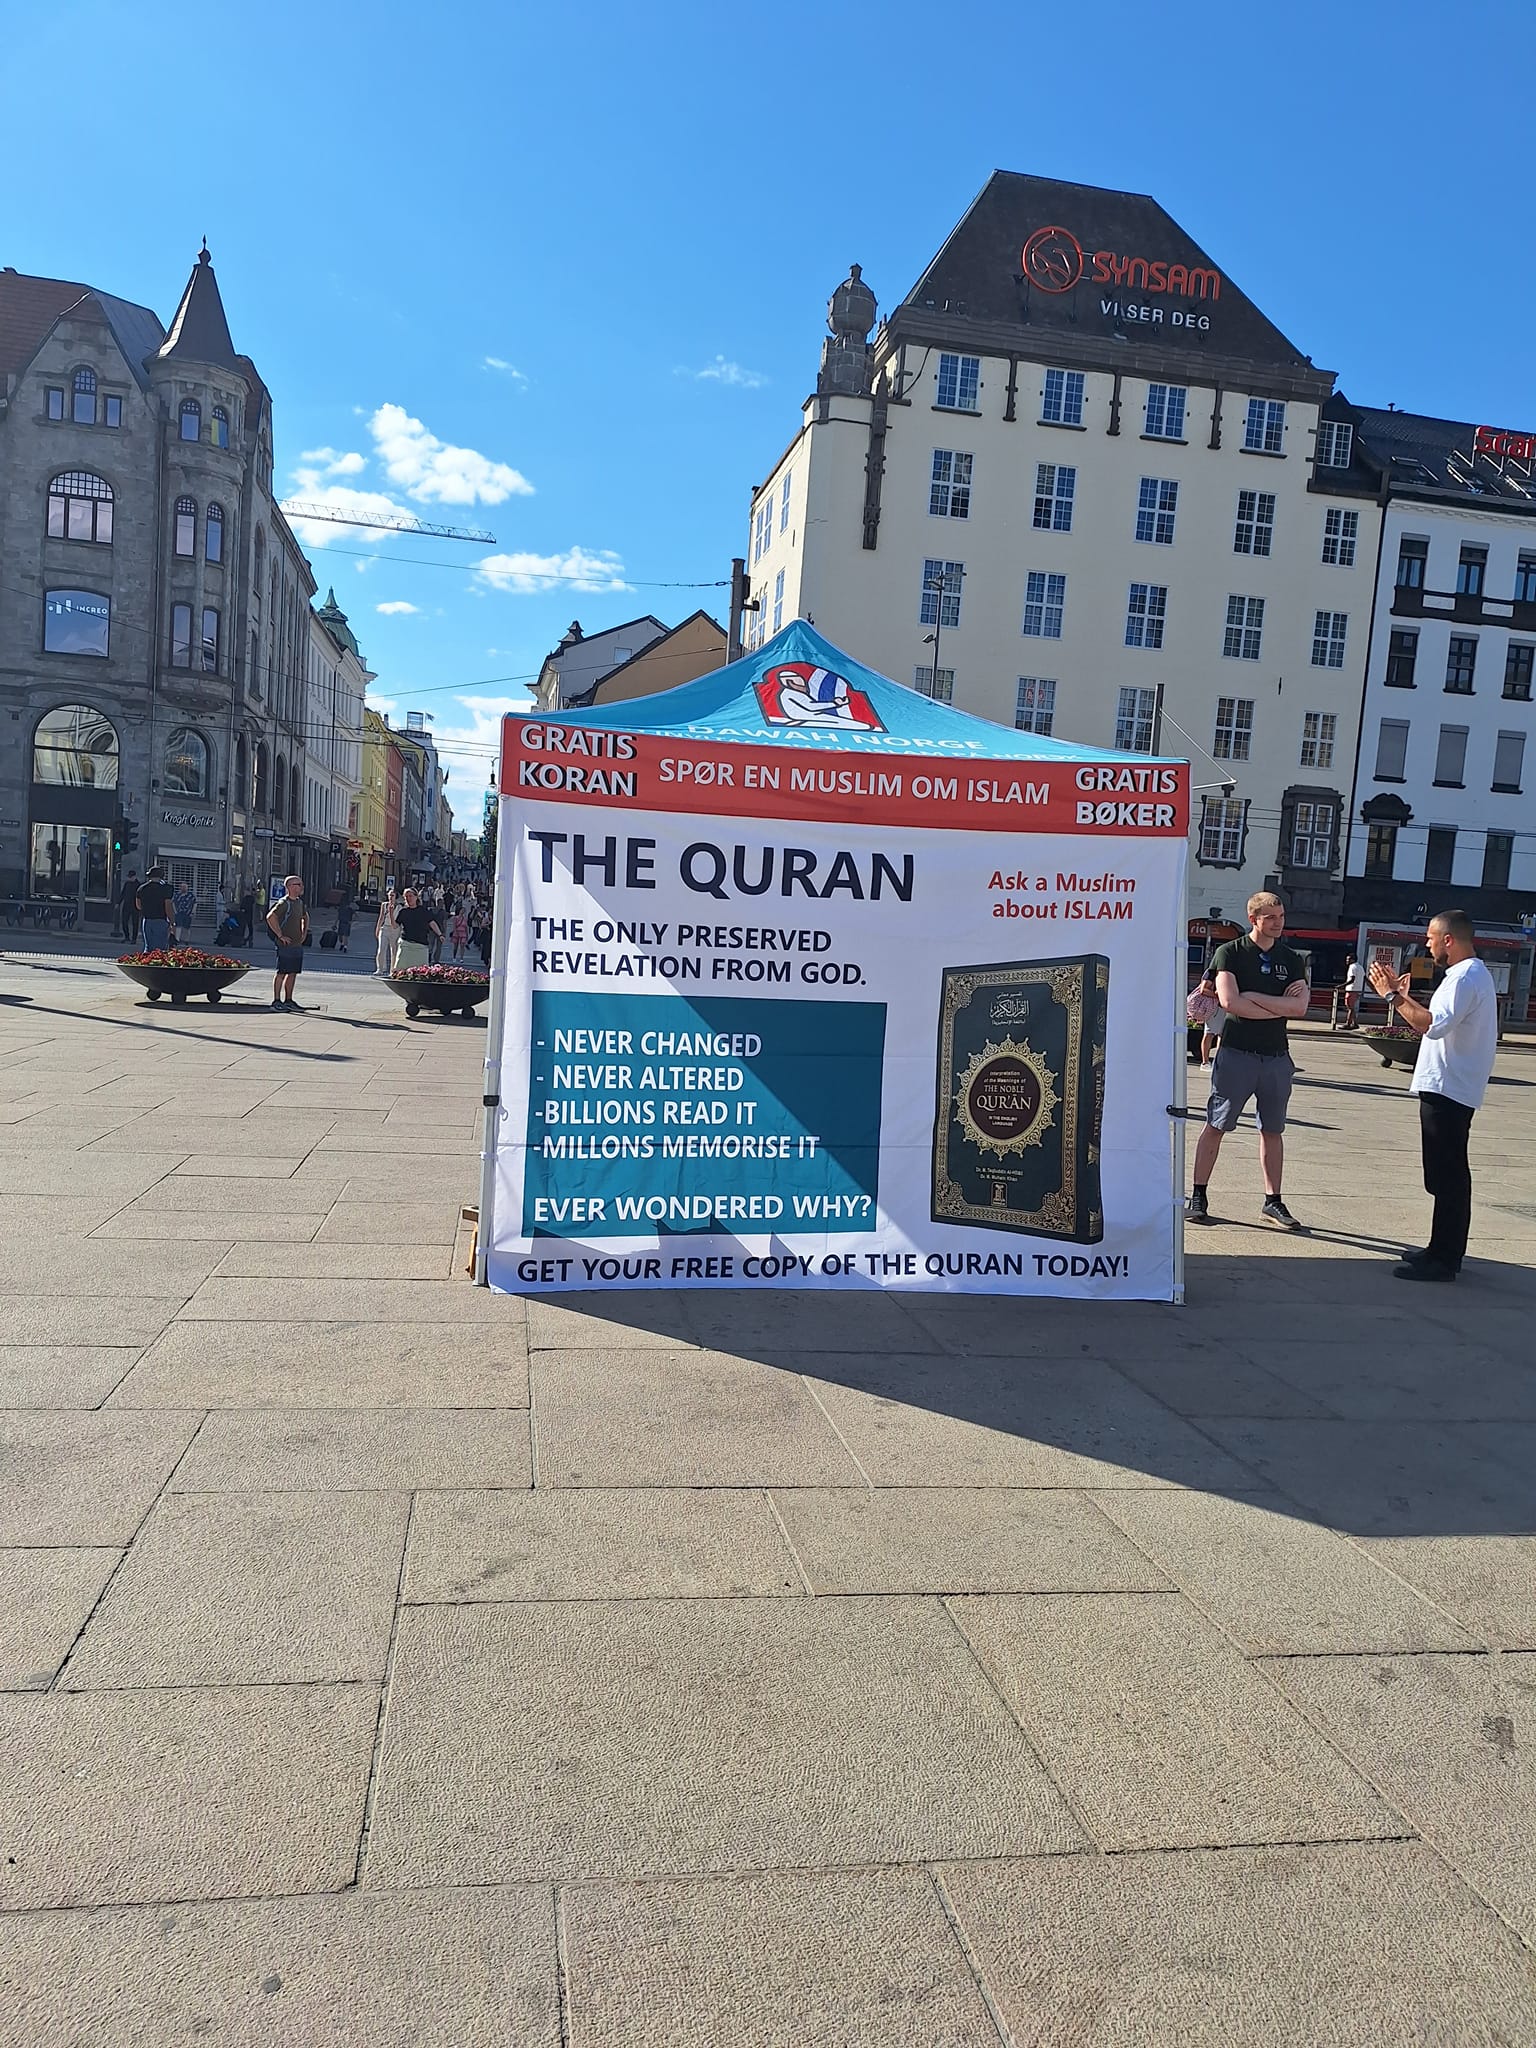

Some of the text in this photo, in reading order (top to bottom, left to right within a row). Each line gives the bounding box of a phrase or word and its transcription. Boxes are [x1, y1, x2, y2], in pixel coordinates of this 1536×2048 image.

[1092, 251, 1220, 301] SYNSAM
[1101, 300, 1210, 330] VI SER DEG
[76, 604, 108, 615] INCREO
[520, 724, 637, 760] GRATIS
[688, 725, 988, 750] DAWAH NORGE
[519, 760, 638, 797] KORAN
[659, 758, 1050, 805] SPØR EN MUSLIM OM ISLAM
[1075, 767, 1178, 794] GRATIS
[1076, 801, 1176, 827] BØKER
[528, 831, 914, 902] THE QURAN
[988, 871, 1136, 892] Ask a Muslim
[992, 899, 1133, 919] about ISLAM
[531, 916, 832, 952] THE ONLY PRESERVED
[532, 950, 866, 986] REVELATION FROM GOD.
[554, 1029, 633, 1055] NEVER
[640, 1032, 762, 1058] CHANGED
[552, 1065, 632, 1090] NEVER
[639, 1067, 744, 1091] ALTERED
[984, 1085, 1025, 1094] THE NOBLE
[535, 1100, 757, 1125] -BILLIONS READ IT
[533, 1135, 821, 1159] -MILLONS MEMORISE IT
[534, 1194, 872, 1222] EVER WONDERED WHY?
[517, 1253, 1129, 1283] GET YOUR FREE COPY OF THE QURAN TODAY!
